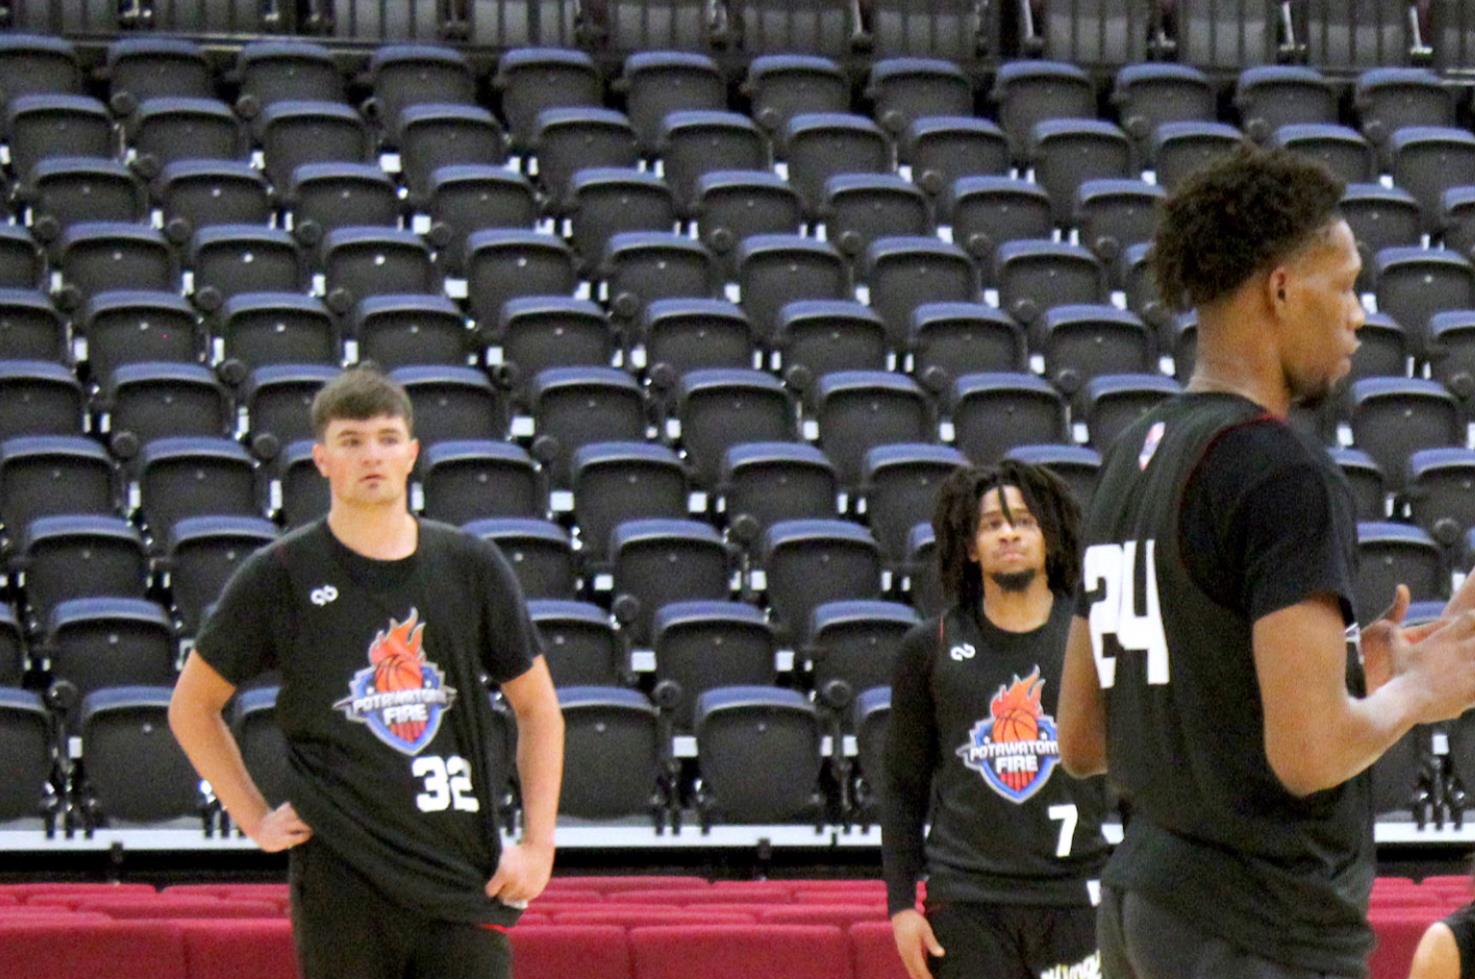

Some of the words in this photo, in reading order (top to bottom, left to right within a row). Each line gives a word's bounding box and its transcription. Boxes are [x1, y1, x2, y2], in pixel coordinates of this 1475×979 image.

[1084, 540, 1170, 688] 24
[383, 703, 428, 726] FIRE
[970, 739, 1059, 762] POTAWATOM
[995, 754, 1039, 775] FIRE
[412, 755, 480, 813] 32
[1048, 803, 1078, 858] 7
